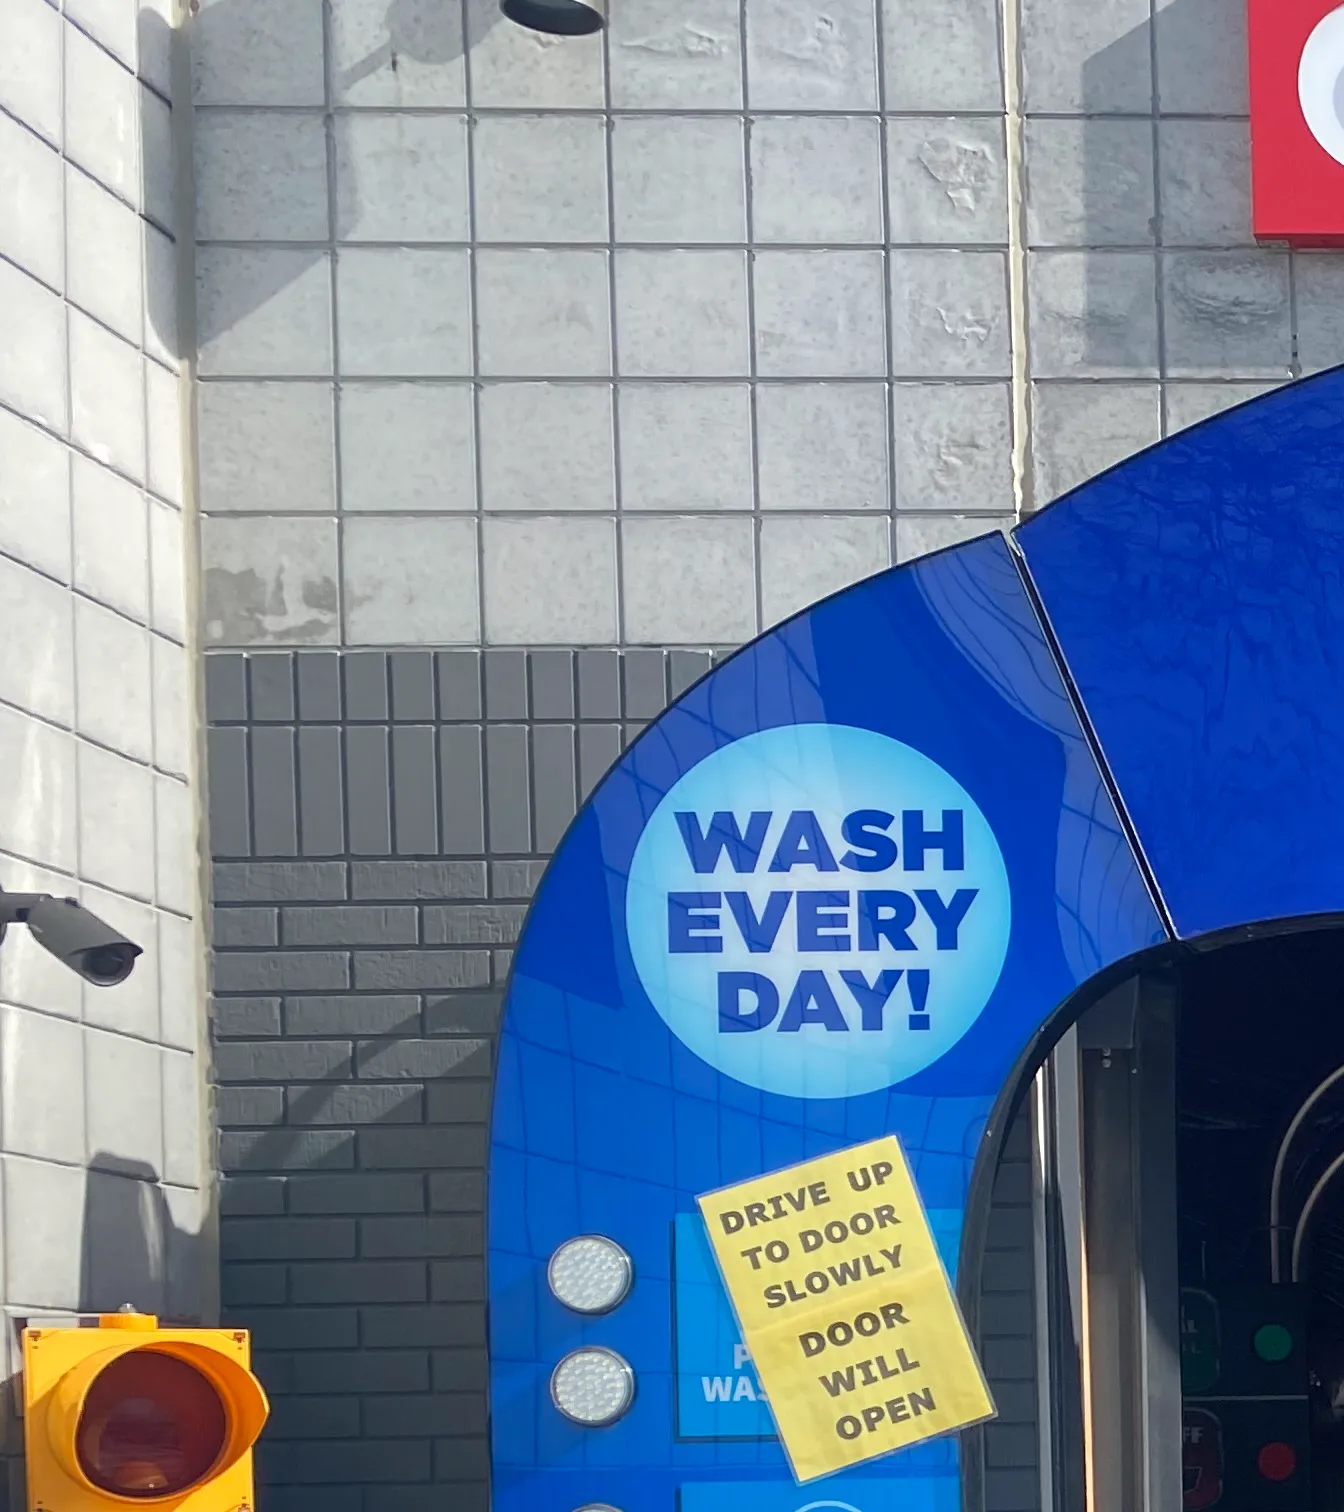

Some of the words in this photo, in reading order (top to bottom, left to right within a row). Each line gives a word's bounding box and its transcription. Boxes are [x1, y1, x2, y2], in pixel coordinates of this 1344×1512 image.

[673, 809, 964, 873] WASH
[667, 889, 979, 953] EVERY
[717, 969, 930, 1033] DAY!
[719, 1181, 830, 1235] DRIVE
[847, 1162, 892, 1192] UP
[741, 1241, 789, 1270] TO
[799, 1204, 901, 1253] DOOR
[763, 1244, 902, 1308] SLOWLY
[799, 1302, 909, 1358] DOOR
[819, 1348, 920, 1397] WILL
[836, 1387, 936, 1440] OPEN
